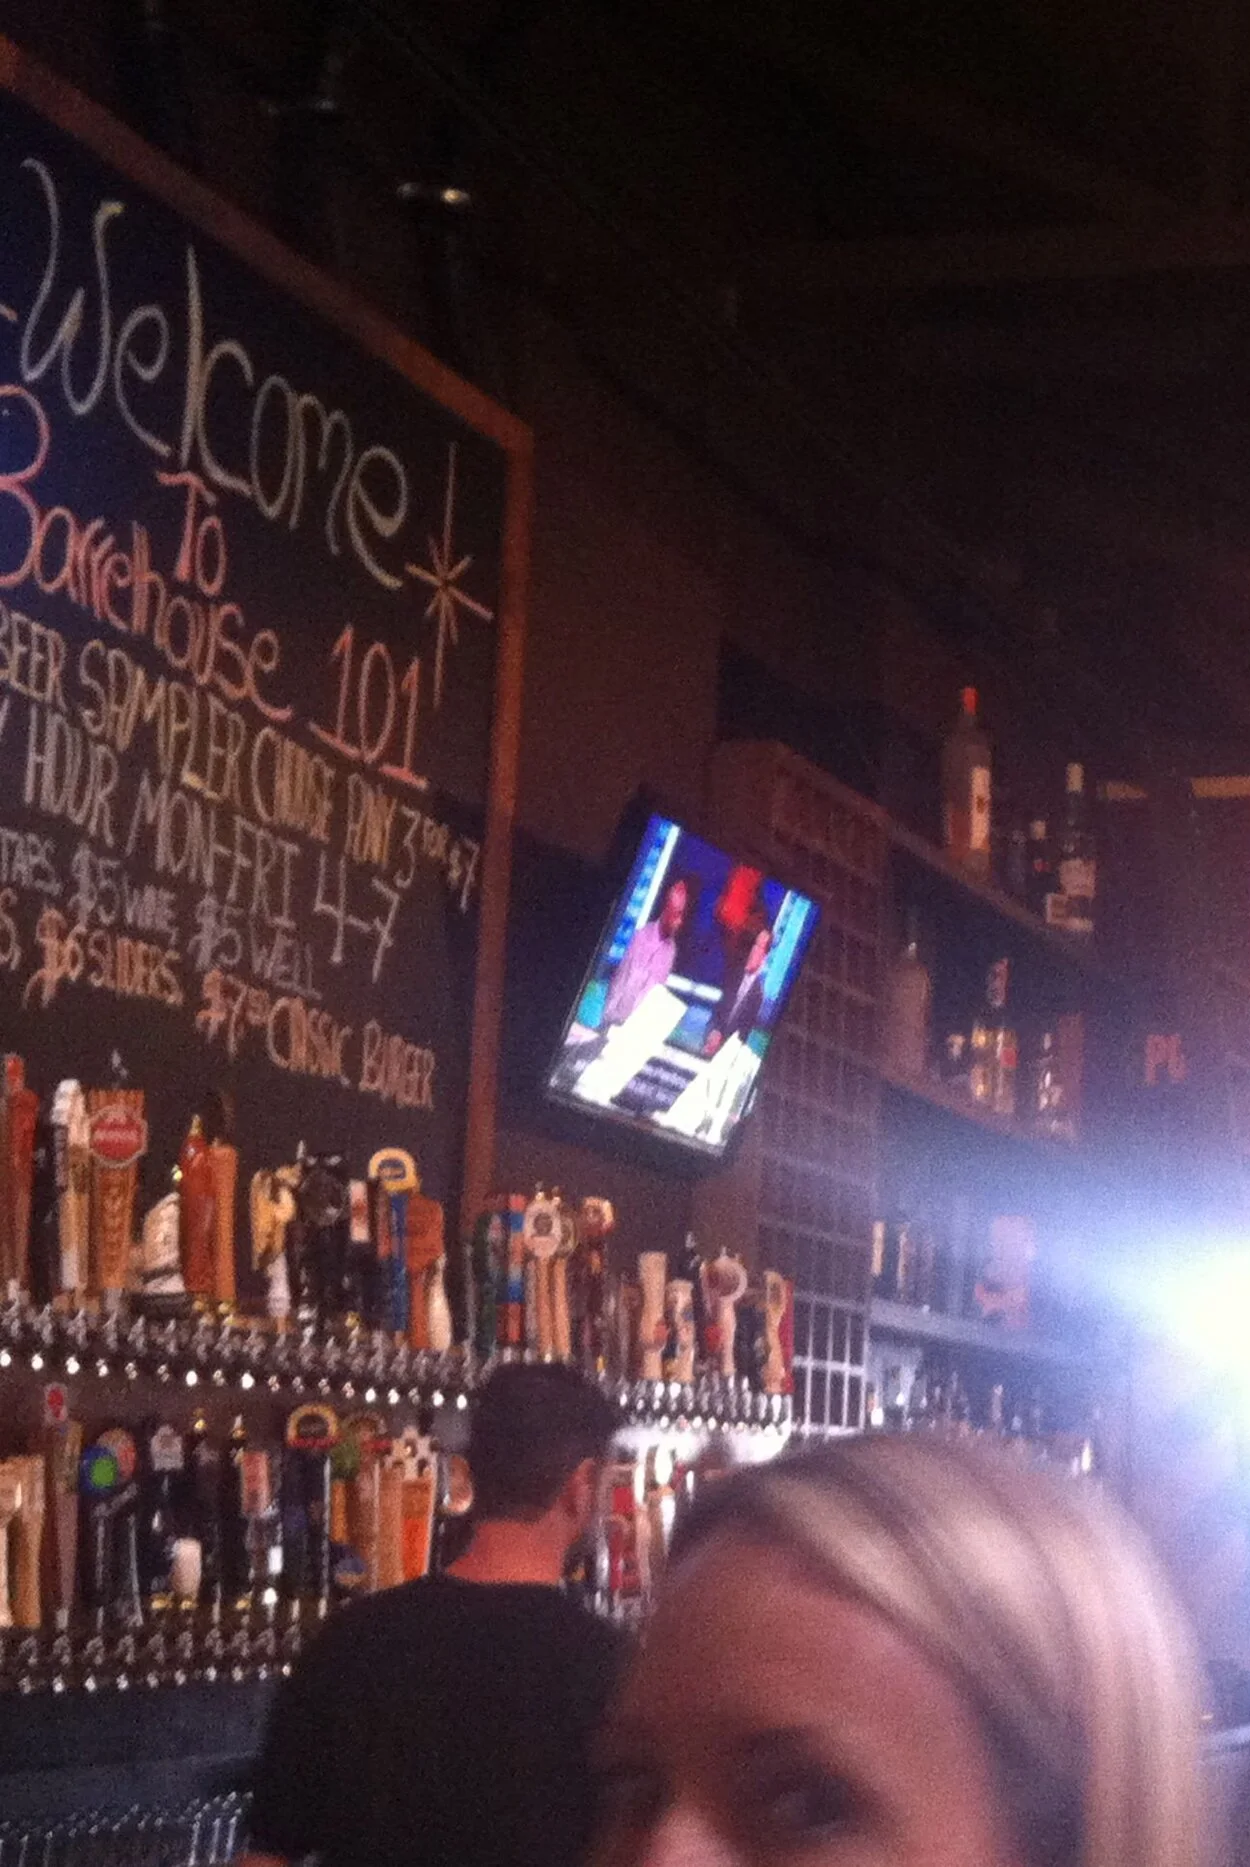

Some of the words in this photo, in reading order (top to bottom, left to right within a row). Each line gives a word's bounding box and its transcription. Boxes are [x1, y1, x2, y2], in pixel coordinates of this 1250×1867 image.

[155, 469, 229, 598] To
[24, 702, 120, 849] HOUR
[78, 638, 247, 808] SAMPLER
[394, 803, 421, 891] 3
[308, 624, 429, 790] 101
